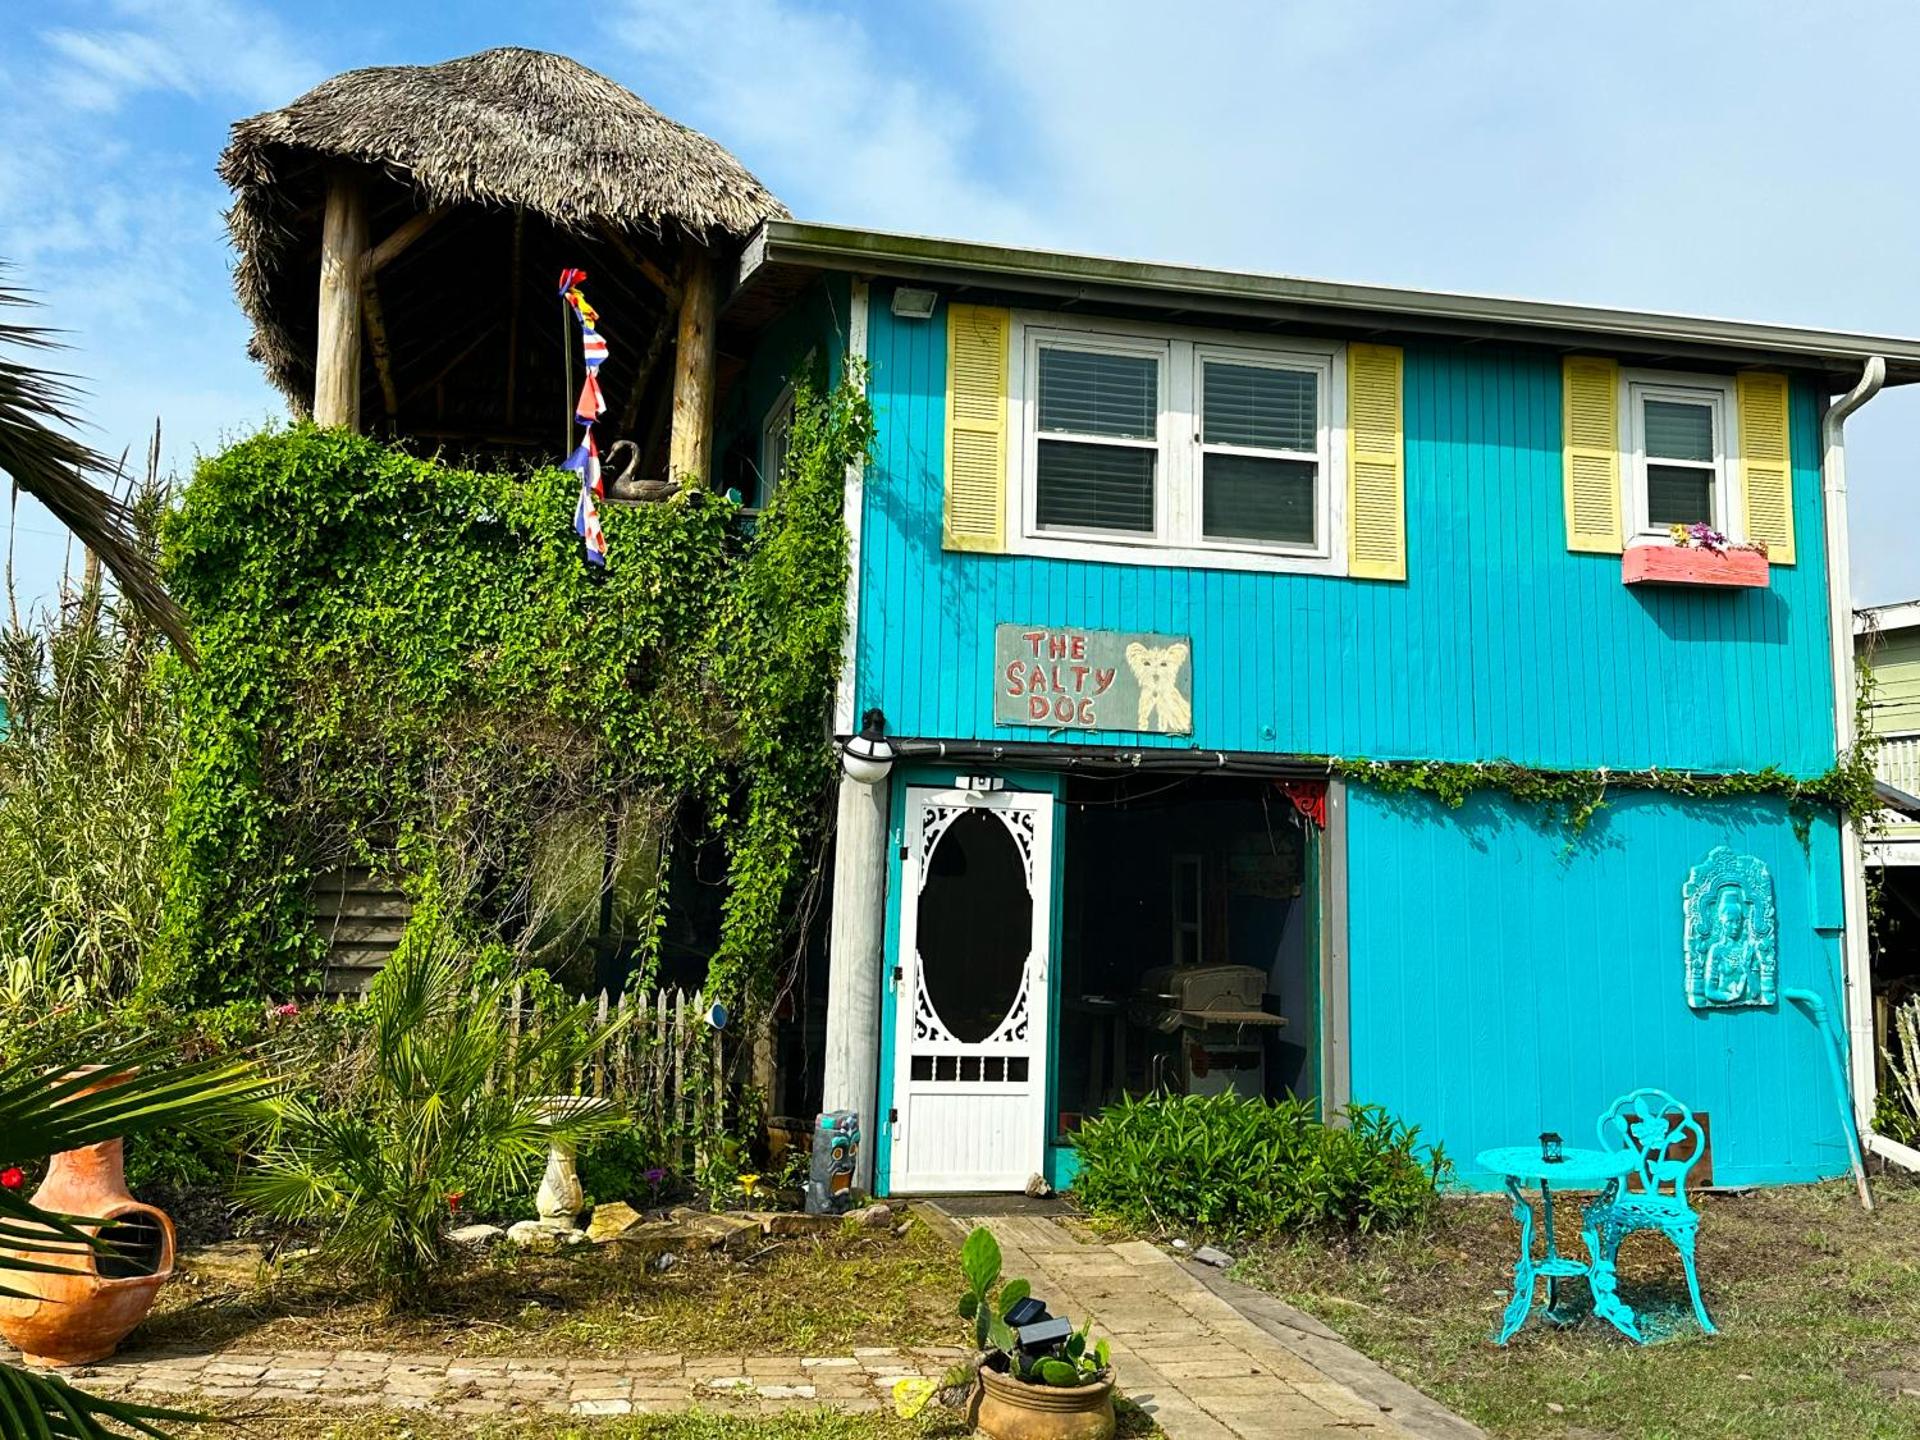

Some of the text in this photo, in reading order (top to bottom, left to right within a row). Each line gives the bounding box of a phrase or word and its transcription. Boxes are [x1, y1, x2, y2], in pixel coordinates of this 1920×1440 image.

[1023, 632, 1087, 661] THE
[1006, 660, 1116, 697] SALTY
[1028, 695, 1096, 725] DOG
